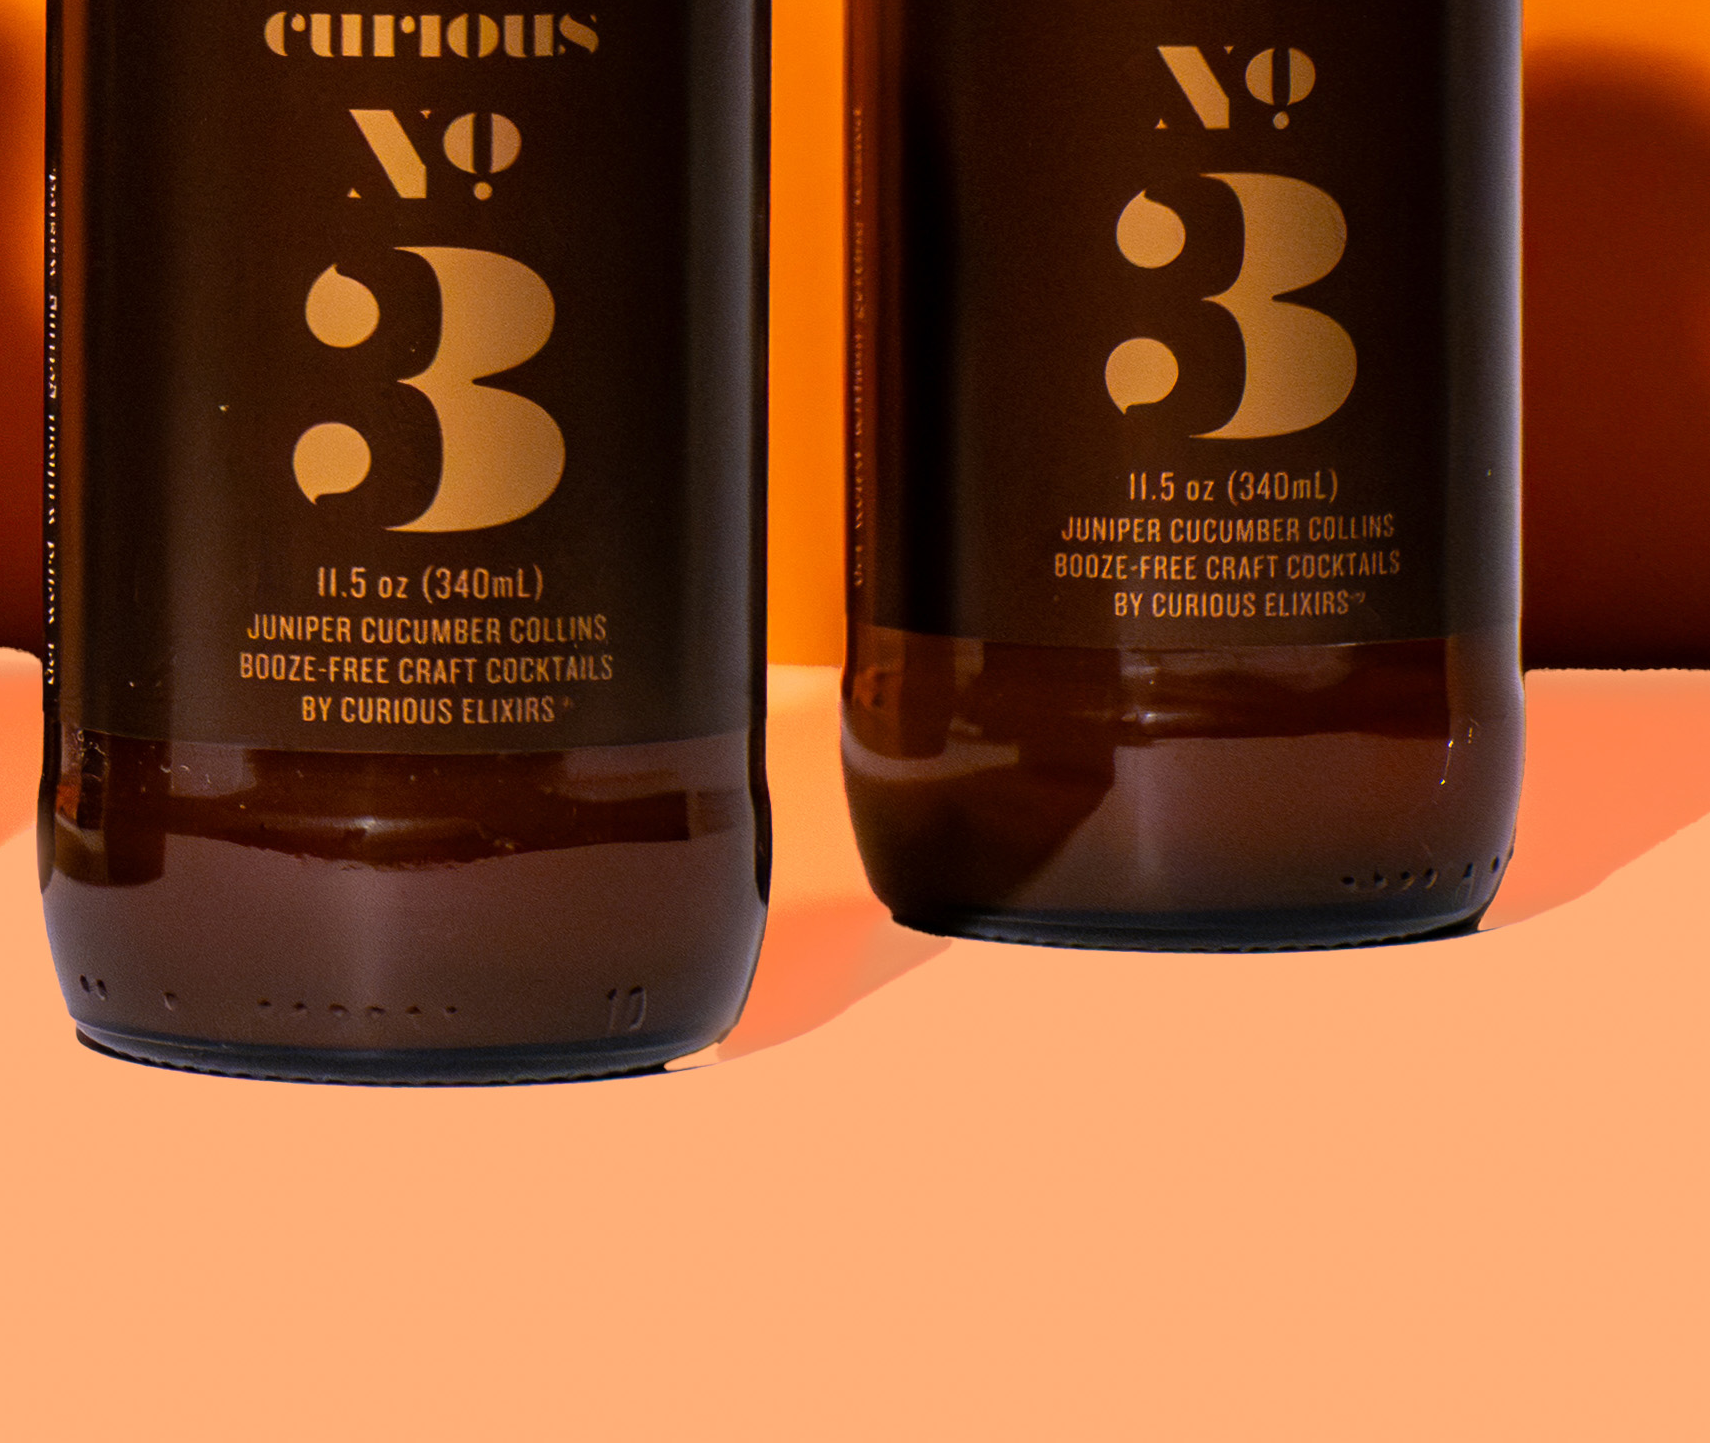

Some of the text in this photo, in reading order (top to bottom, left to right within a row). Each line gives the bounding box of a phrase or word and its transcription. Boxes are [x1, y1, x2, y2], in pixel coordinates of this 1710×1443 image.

[263, 10, 600, 59] curious
[1104, 172, 1358, 440] 3
[292, 245, 566, 533] 3
[1130, 469, 1338, 506] 11.5 oz (340mL)
[1061, 513, 1395, 544] JUNIPER CUCUMBER COLLINS
[1055, 550, 1400, 581] BOOZE-FREE CRAFT COCKTAILS
[318, 564, 543, 604] 11.5 oz (340mL)
[1115, 592, 1143, 617] BY
[1152, 592, 1256, 618] CURIOUS
[246, 613, 607, 645] JUNIPER CUCUMBER COLLINS
[240, 652, 613, 685] BOOZE-FREE CRAFT COCKTAILS
[302, 695, 332, 722] BY
[341, 697, 452, 725] CURIOUS
